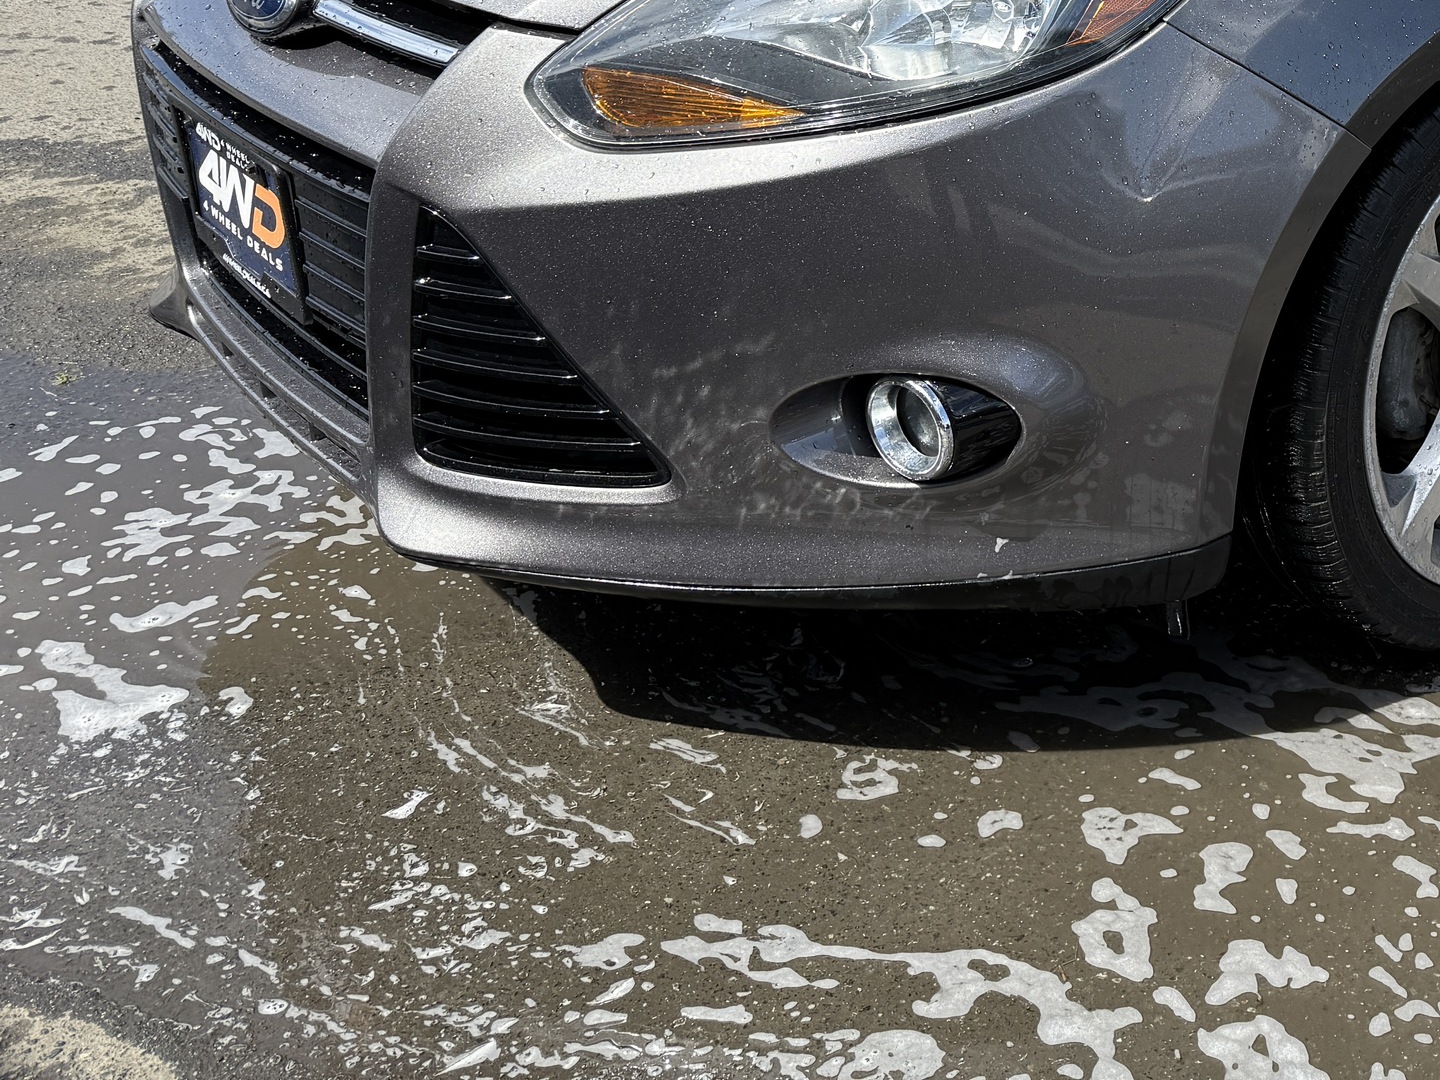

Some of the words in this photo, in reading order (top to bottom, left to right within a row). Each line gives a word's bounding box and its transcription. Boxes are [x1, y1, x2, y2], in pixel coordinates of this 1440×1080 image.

[198, 149, 286, 249] 4WD
[210, 204, 244, 240] WHEEL
[246, 235, 284, 272] DEALS
